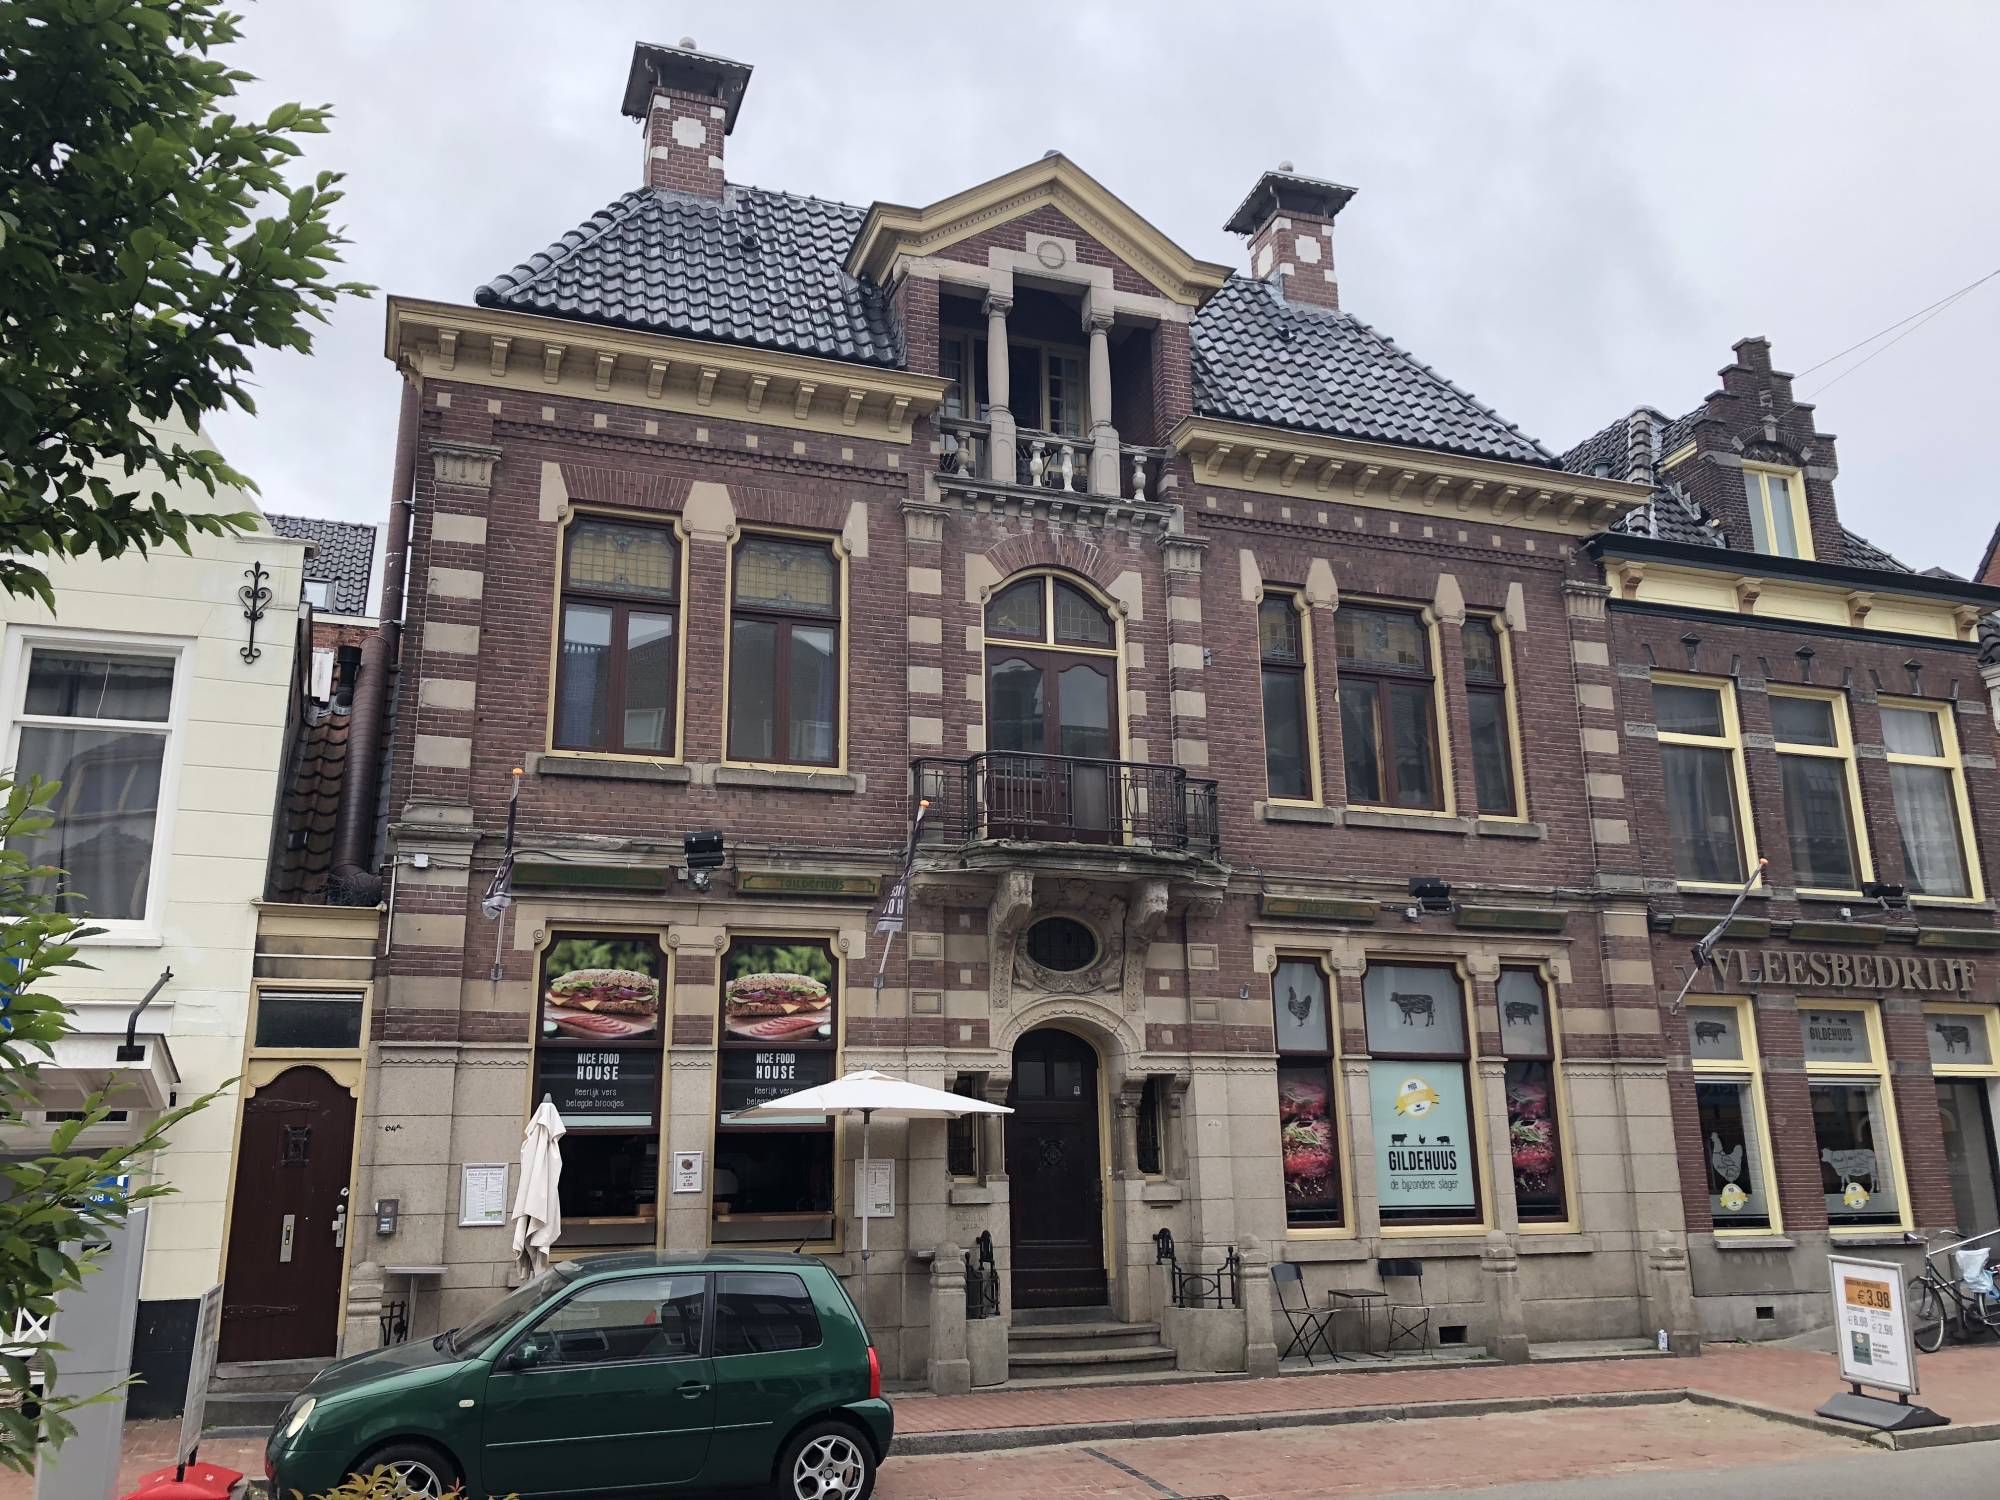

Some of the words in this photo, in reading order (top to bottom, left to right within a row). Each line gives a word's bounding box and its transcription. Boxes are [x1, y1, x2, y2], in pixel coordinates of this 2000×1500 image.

[1711, 949, 1977, 992] VLEESBEDRIJF
[577, 1053, 597, 1064] NICE
[599, 1053, 620, 1064] FOOD
[756, 1053, 774, 1064] NICE
[776, 1053, 796, 1064] FOOD
[576, 1066, 619, 1080] HOUSE
[756, 1065, 795, 1079] HOUSE
[1388, 1150, 1457, 1171] GILDEHUUS
[1390, 1179, 1399, 1190] de
[1438, 1179, 1459, 1191] slager
